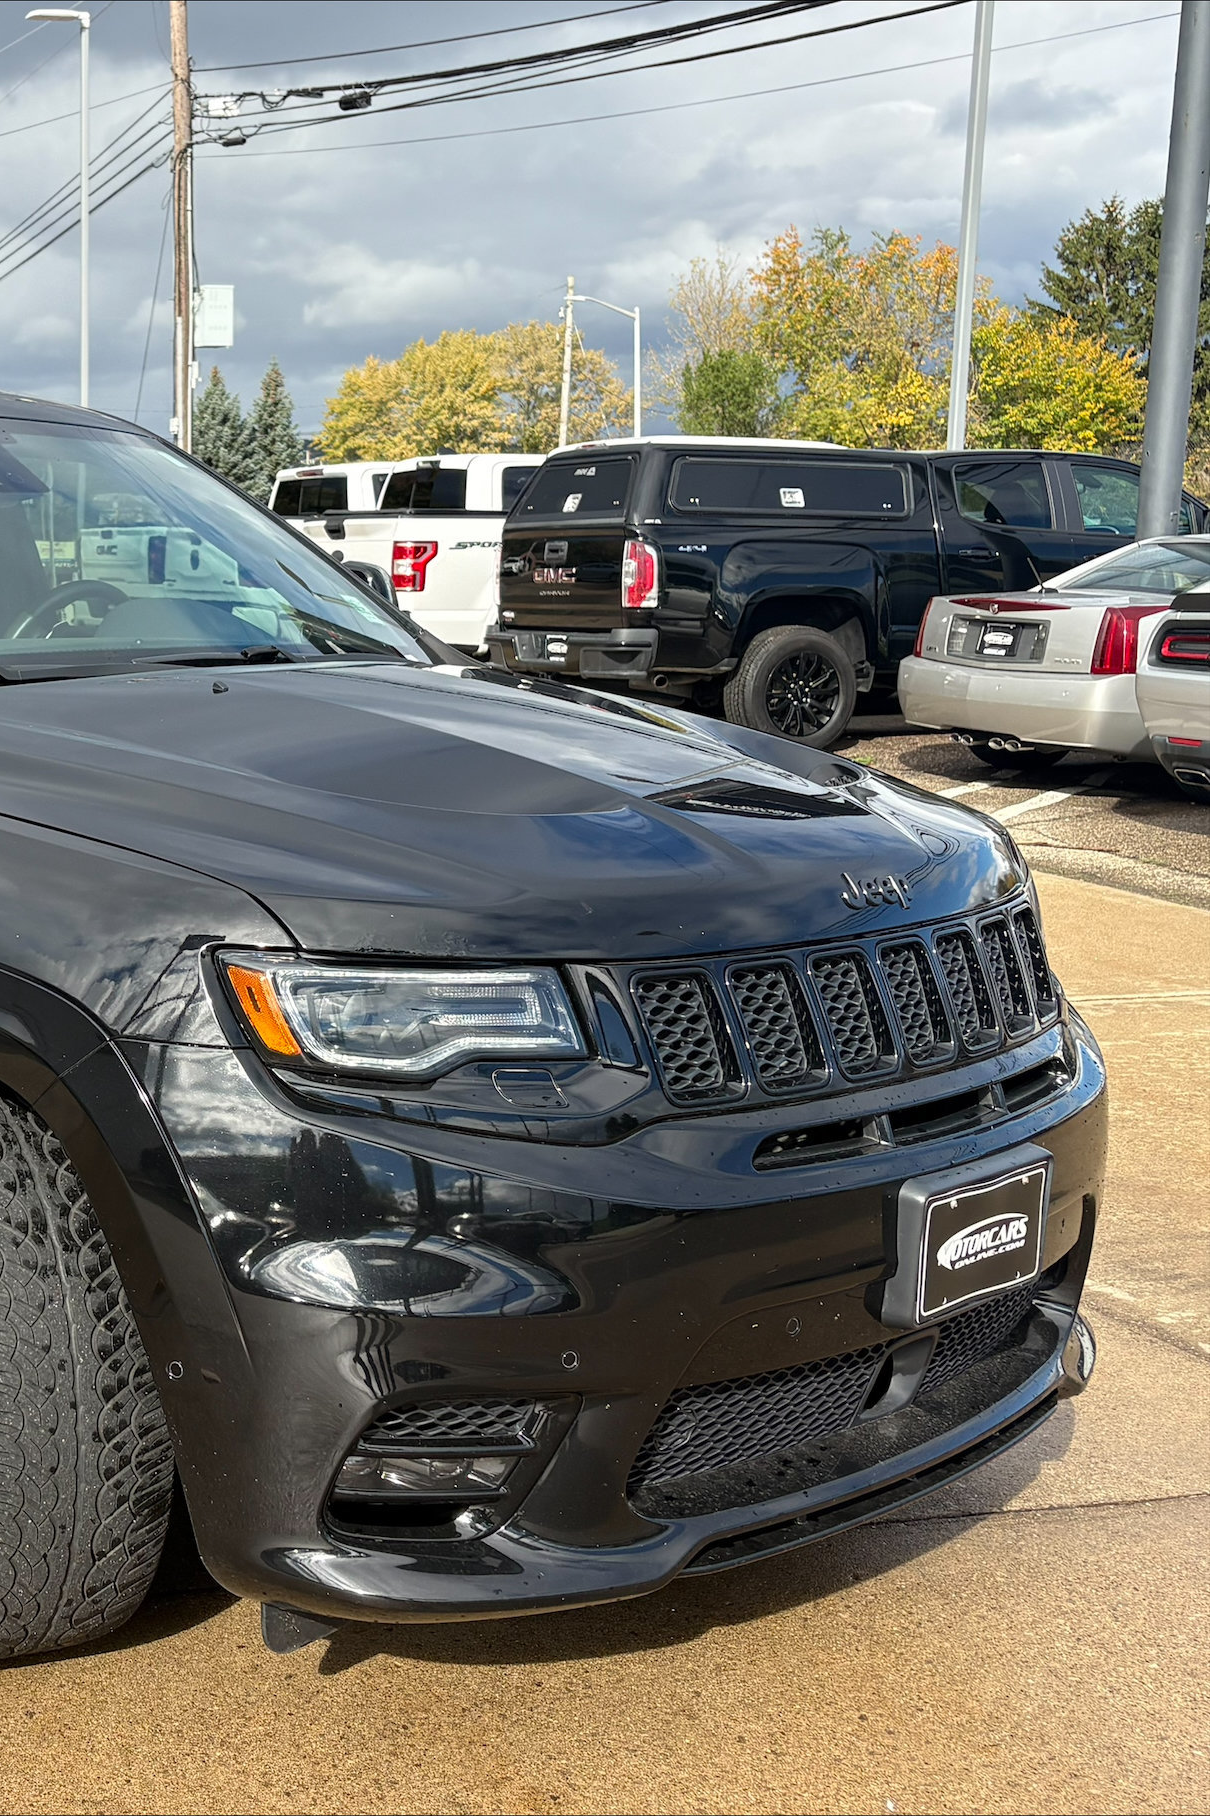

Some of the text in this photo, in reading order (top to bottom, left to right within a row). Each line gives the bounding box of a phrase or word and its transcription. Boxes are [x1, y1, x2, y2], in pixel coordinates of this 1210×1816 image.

[533, 567, 577, 584] GMC
[840, 872, 913, 910] Jeep
[953, 1239, 1026, 1270] ONLINE.COM
